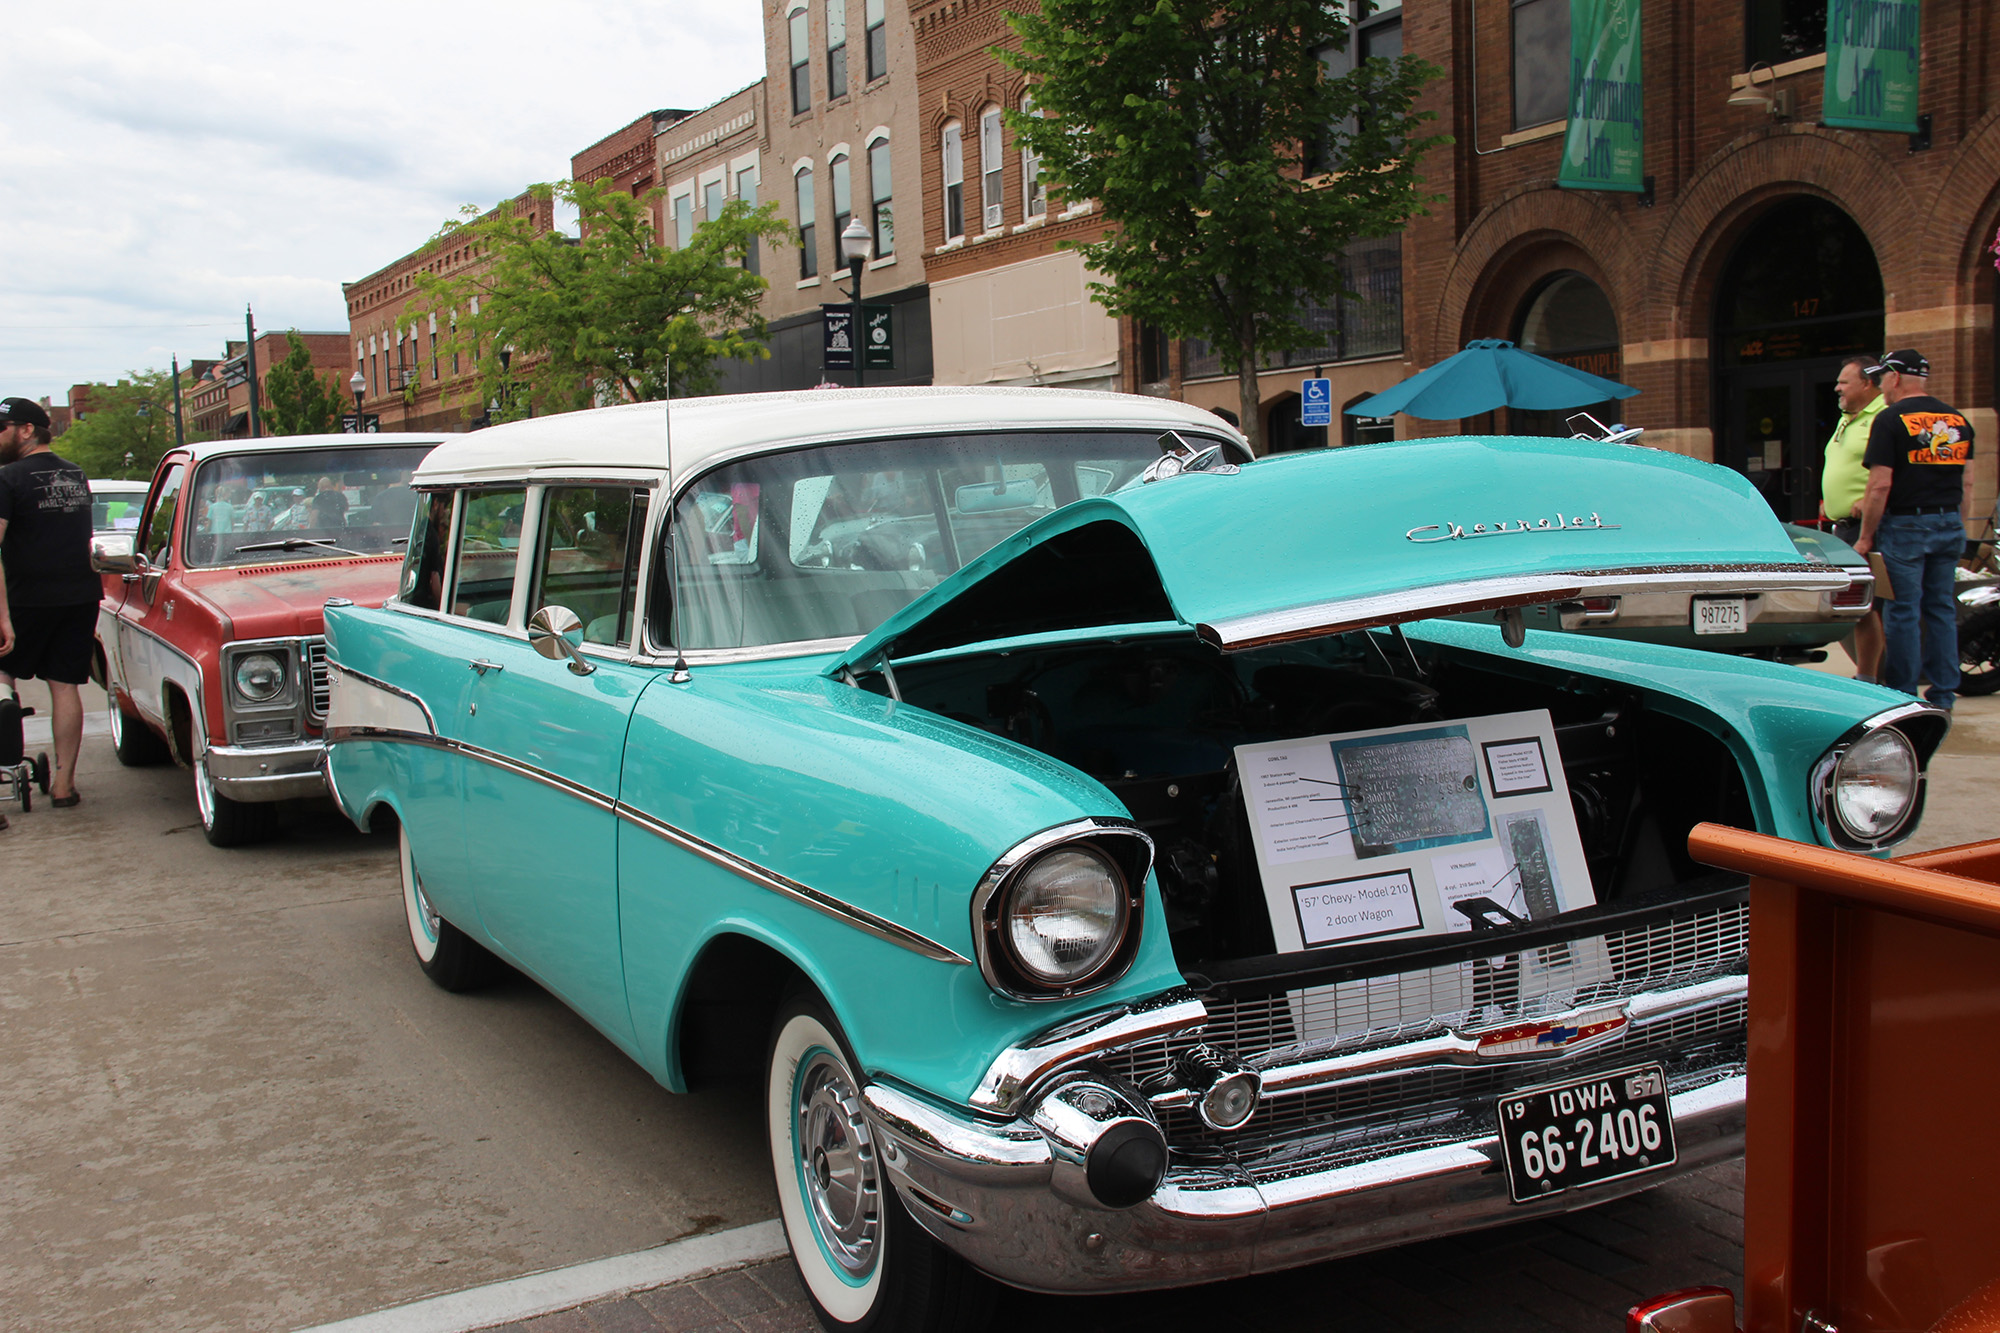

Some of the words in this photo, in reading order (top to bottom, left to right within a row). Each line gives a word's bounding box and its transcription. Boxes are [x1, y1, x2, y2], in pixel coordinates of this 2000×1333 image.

[1848, 50, 1882, 117] Arts
[1572, 58, 1642, 142] Performing
[1580, 120, 1611, 179] Arts
[1792, 298, 1819, 317] 147
[1573, 353, 1621, 376] TEMPLE
[45, 487, 62, 499] LAS
[1406, 512, 1622, 543] Chevrolet
[1701, 606, 1740, 624] 987275
[1322, 893, 1356, 906] Chevy-
[1358, 886, 1389, 900] Model
[1389, 883, 1409, 896] 210
[1325, 916, 1333, 927] 2
[1334, 914, 1358, 925] door
[1358, 908, 1394, 922] Wagon
[1507, 1102, 1525, 1120] 19
[1550, 1082, 1616, 1118] IOWA
[1632, 1076, 1655, 1096] 57
[1520, 1103, 1661, 1179] 66-2406
